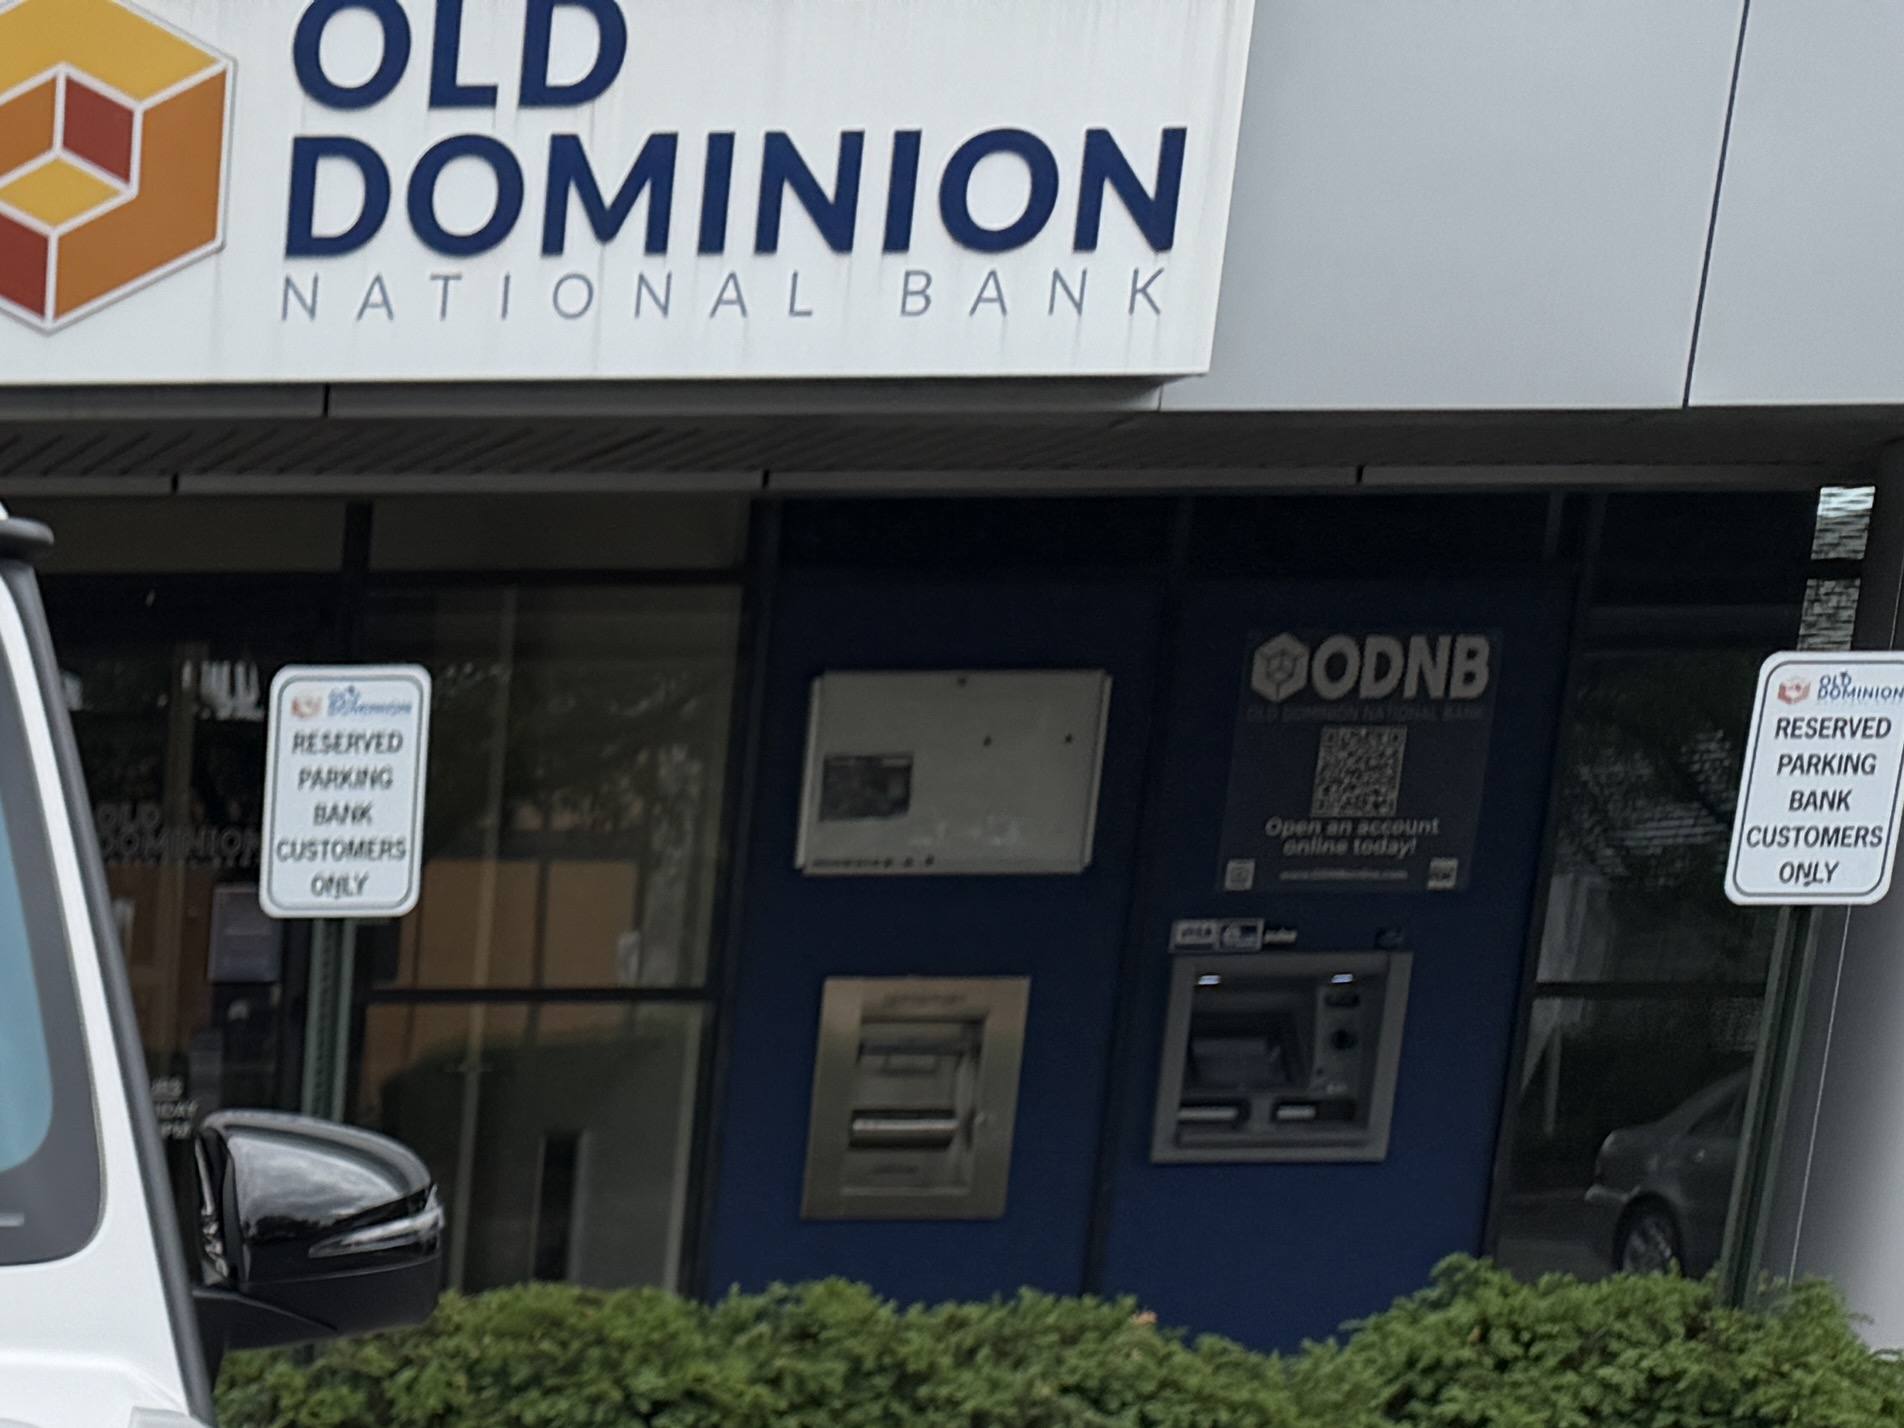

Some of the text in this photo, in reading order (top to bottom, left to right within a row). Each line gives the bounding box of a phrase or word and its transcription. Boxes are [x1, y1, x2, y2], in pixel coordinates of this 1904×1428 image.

[292, 0, 629, 110] OLD
[286, 126, 1188, 260] DOMINION
[279, 266, 1166, 322] NATIONAL BANK
[1311, 632, 1490, 701] ODNB
[1774, 717, 1892, 740] RESERVED
[292, 728, 403, 755] RESERVED
[1776, 753, 1877, 776] PARKING
[297, 765, 394, 791] PARKING
[313, 801, 374, 826] BANK
[1788, 790, 1853, 812] BANK
[1265, 816, 1439, 839] Open an account
[1746, 826, 1884, 848] CUSTOMERS
[276, 837, 407, 863] CUSTOMERS
[1283, 836, 1418, 860] online today!
[311, 871, 369, 898] ONLY
[1779, 861, 1839, 885] ONLY
